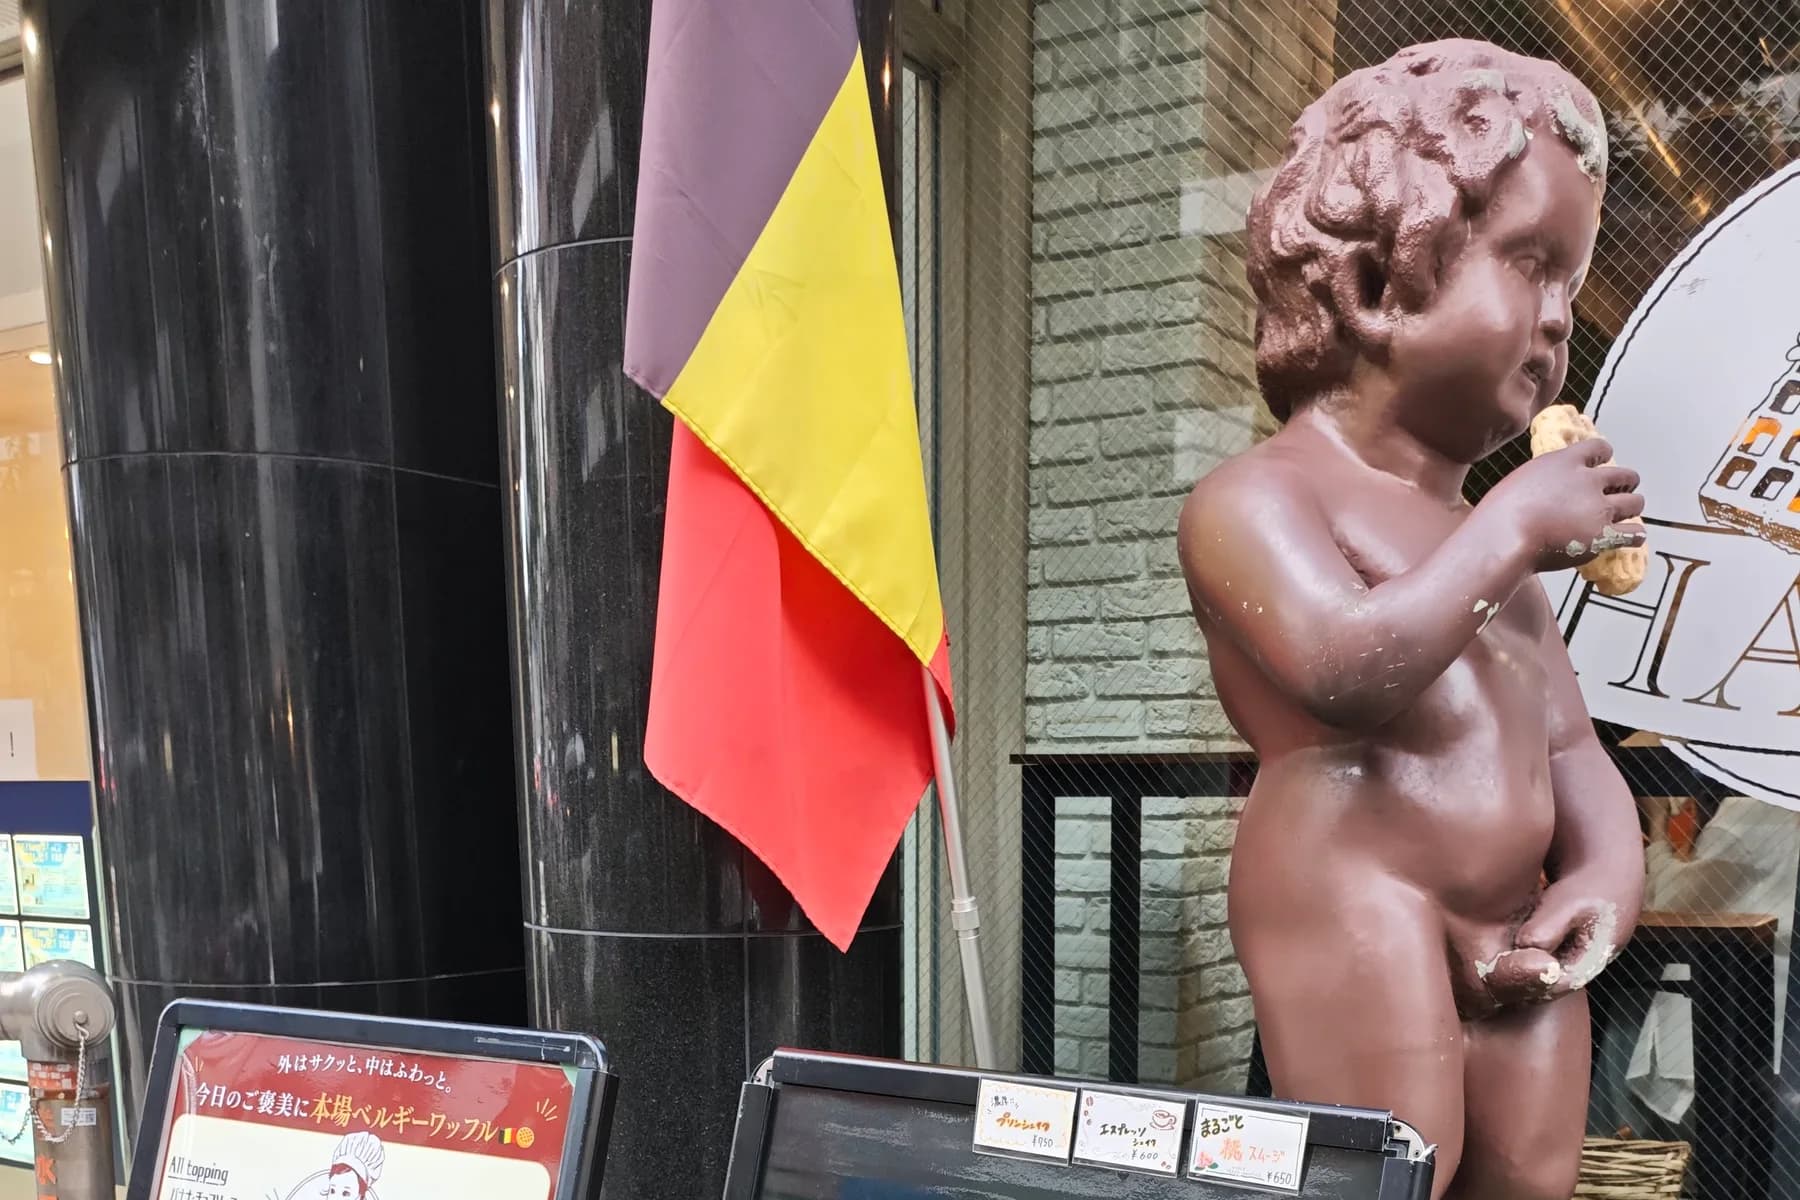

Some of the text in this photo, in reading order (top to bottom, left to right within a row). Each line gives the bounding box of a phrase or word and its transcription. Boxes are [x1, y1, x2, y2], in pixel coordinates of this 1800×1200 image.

[277, 1054, 452, 1093] 外はサクッと、中はふわっと。
[1099, 1123, 1147, 1138] エスプレッソ
[1200, 1114, 1245, 1138] まるごと
[169, 1156, 229, 1186] All topping
[1266, 1171, 1293, 1186] ¥650
